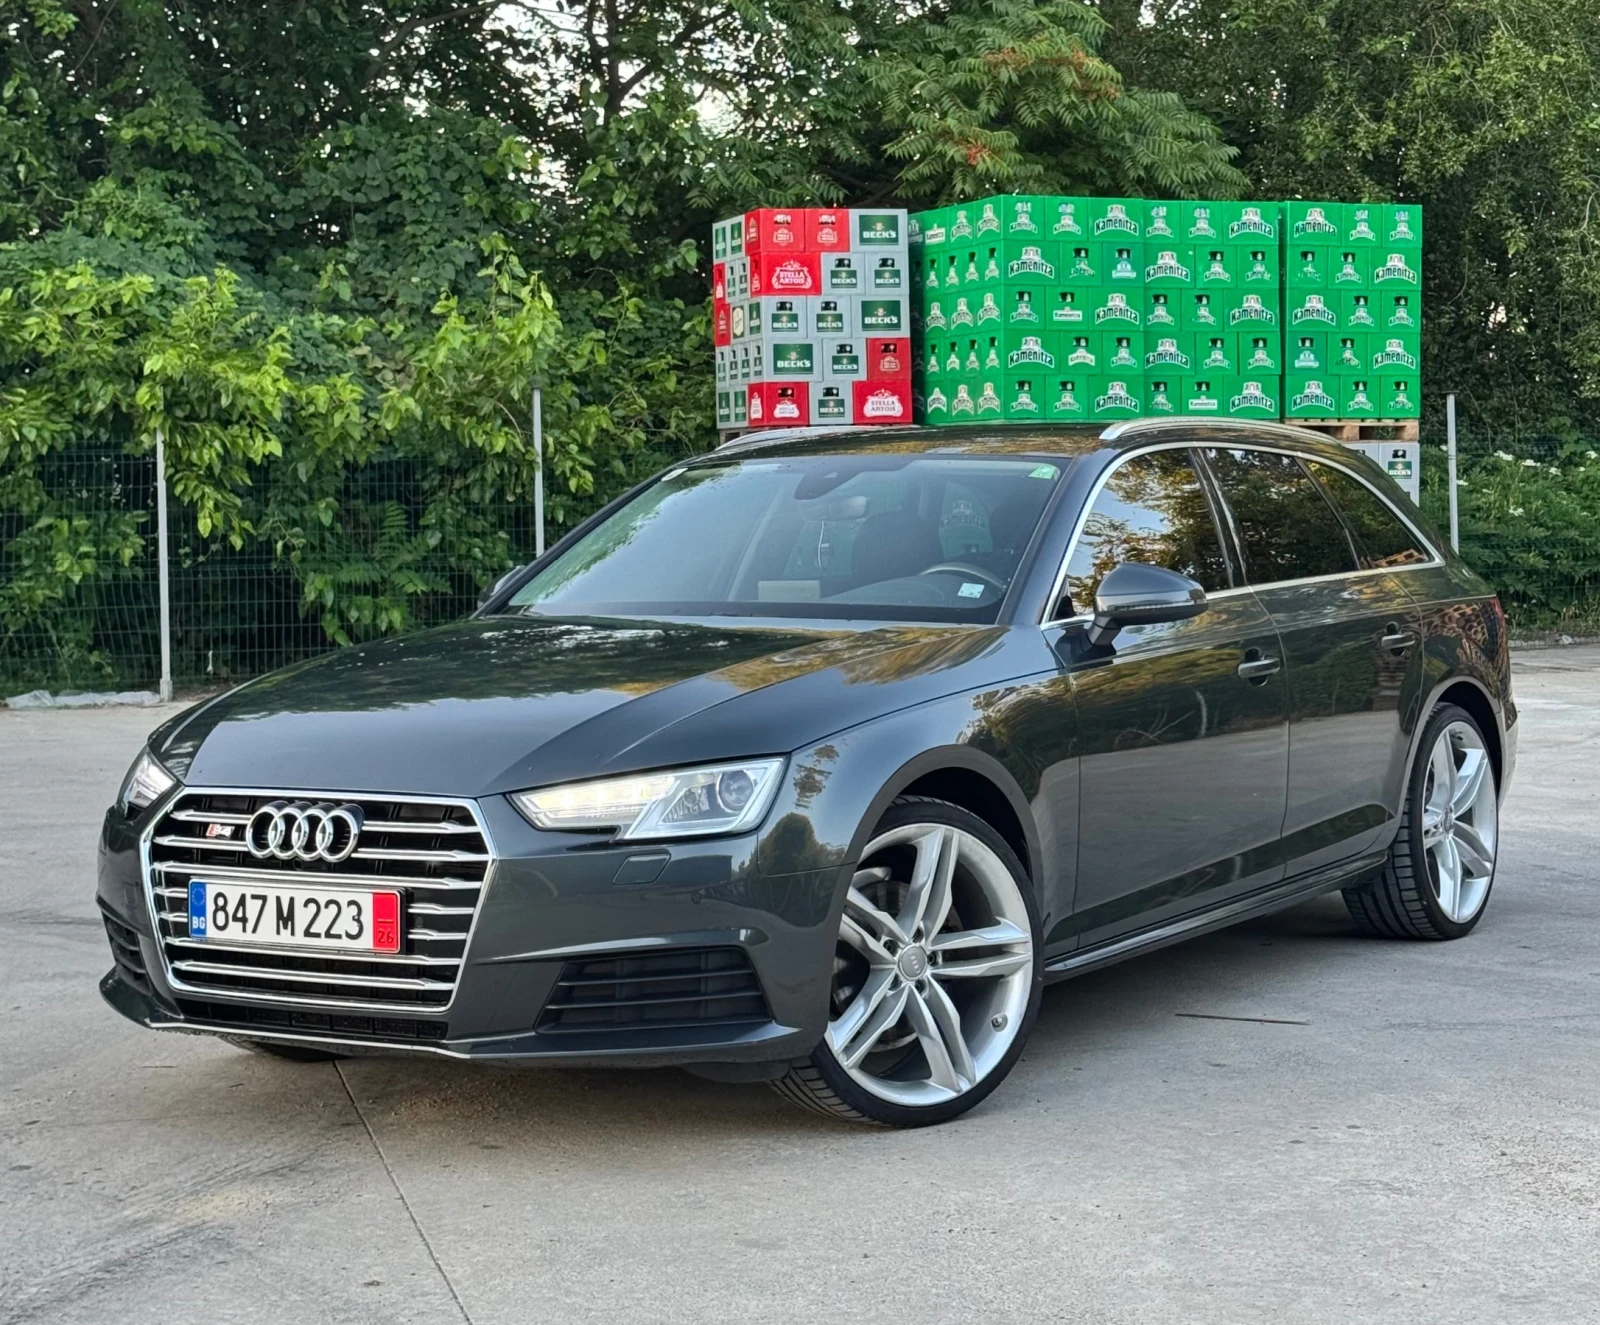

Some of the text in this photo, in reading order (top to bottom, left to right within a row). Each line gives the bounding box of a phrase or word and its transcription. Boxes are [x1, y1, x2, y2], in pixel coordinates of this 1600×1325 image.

[1096, 219, 1137, 233] Kamenitza
[1231, 221, 1271, 235] Kamenitza
[1295, 221, 1336, 236] Kamenitza
[863, 230, 896, 238] BECK'S
[1010, 260, 1052, 277] Kamenitza
[1147, 264, 1189, 279] Kamenitza
[1376, 267, 1415, 281] Kamenitza
[865, 316, 898, 324] BECK'S
[1096, 307, 1137, 322] Kamenitza
[1231, 307, 1273, 322] Kamenitza
[1294, 307, 1334, 322] Kamenitza
[777, 359, 811, 367] BECK'S
[1010, 350, 1053, 365] Kamenitza
[1146, 352, 1188, 365] Kamenitza
[1374, 352, 1414, 366] Kamenitza
[1096, 395, 1137, 410] Kamenitza
[1232, 395, 1273, 409] Kamenitza
[1293, 394, 1333, 409] Kamenitza
[192, 916, 205, 929] BG
[212, 892, 364, 940] 847 M 223
[378, 930, 394, 944] 26
